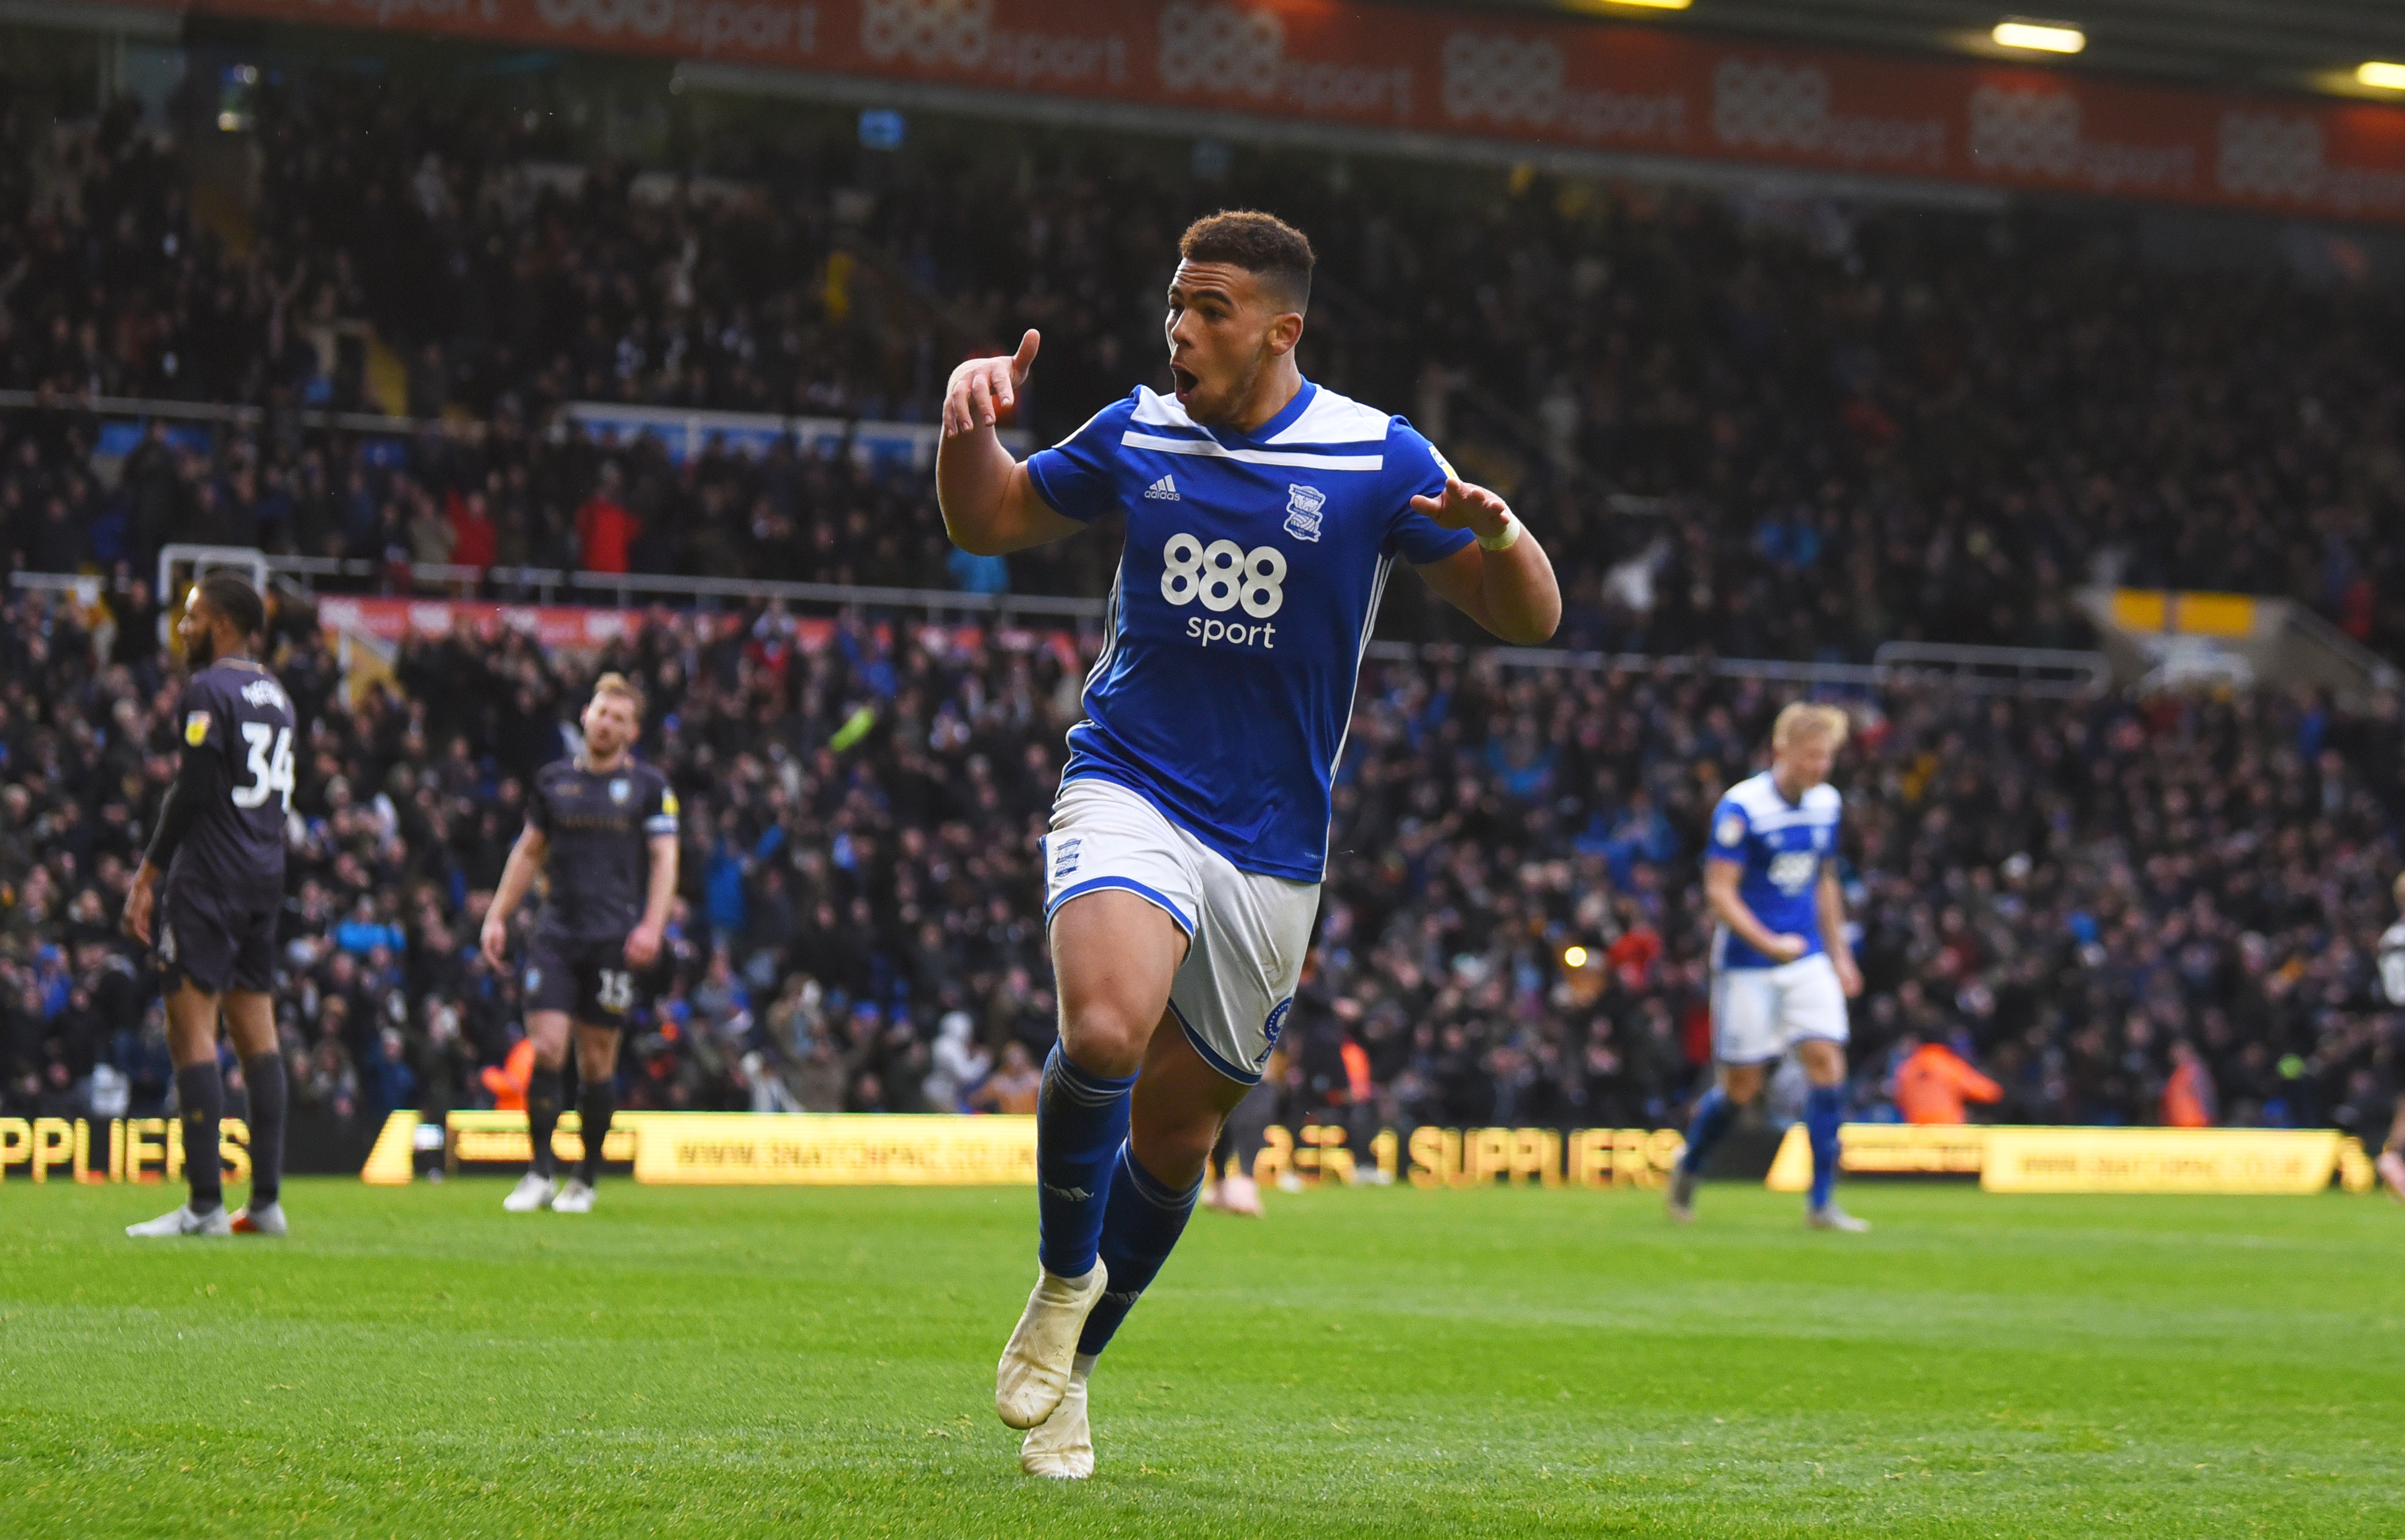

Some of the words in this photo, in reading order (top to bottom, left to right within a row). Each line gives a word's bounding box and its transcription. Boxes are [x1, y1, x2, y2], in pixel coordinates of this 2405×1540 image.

[1156, 2, 1285, 97] 888
[1442, 30, 1564, 126] 888
[1712, 56, 1830, 153] 888
[1969, 83, 2082, 177] 888
[2217, 107, 2325, 200] 888
[1144, 489, 1180, 501] adidas
[1161, 533, 1287, 618] 888
[1186, 617, 1276, 648] sport
[231, 720, 296, 814] 34
[1408, 1125, 1687, 1190] SUPPLIERS
